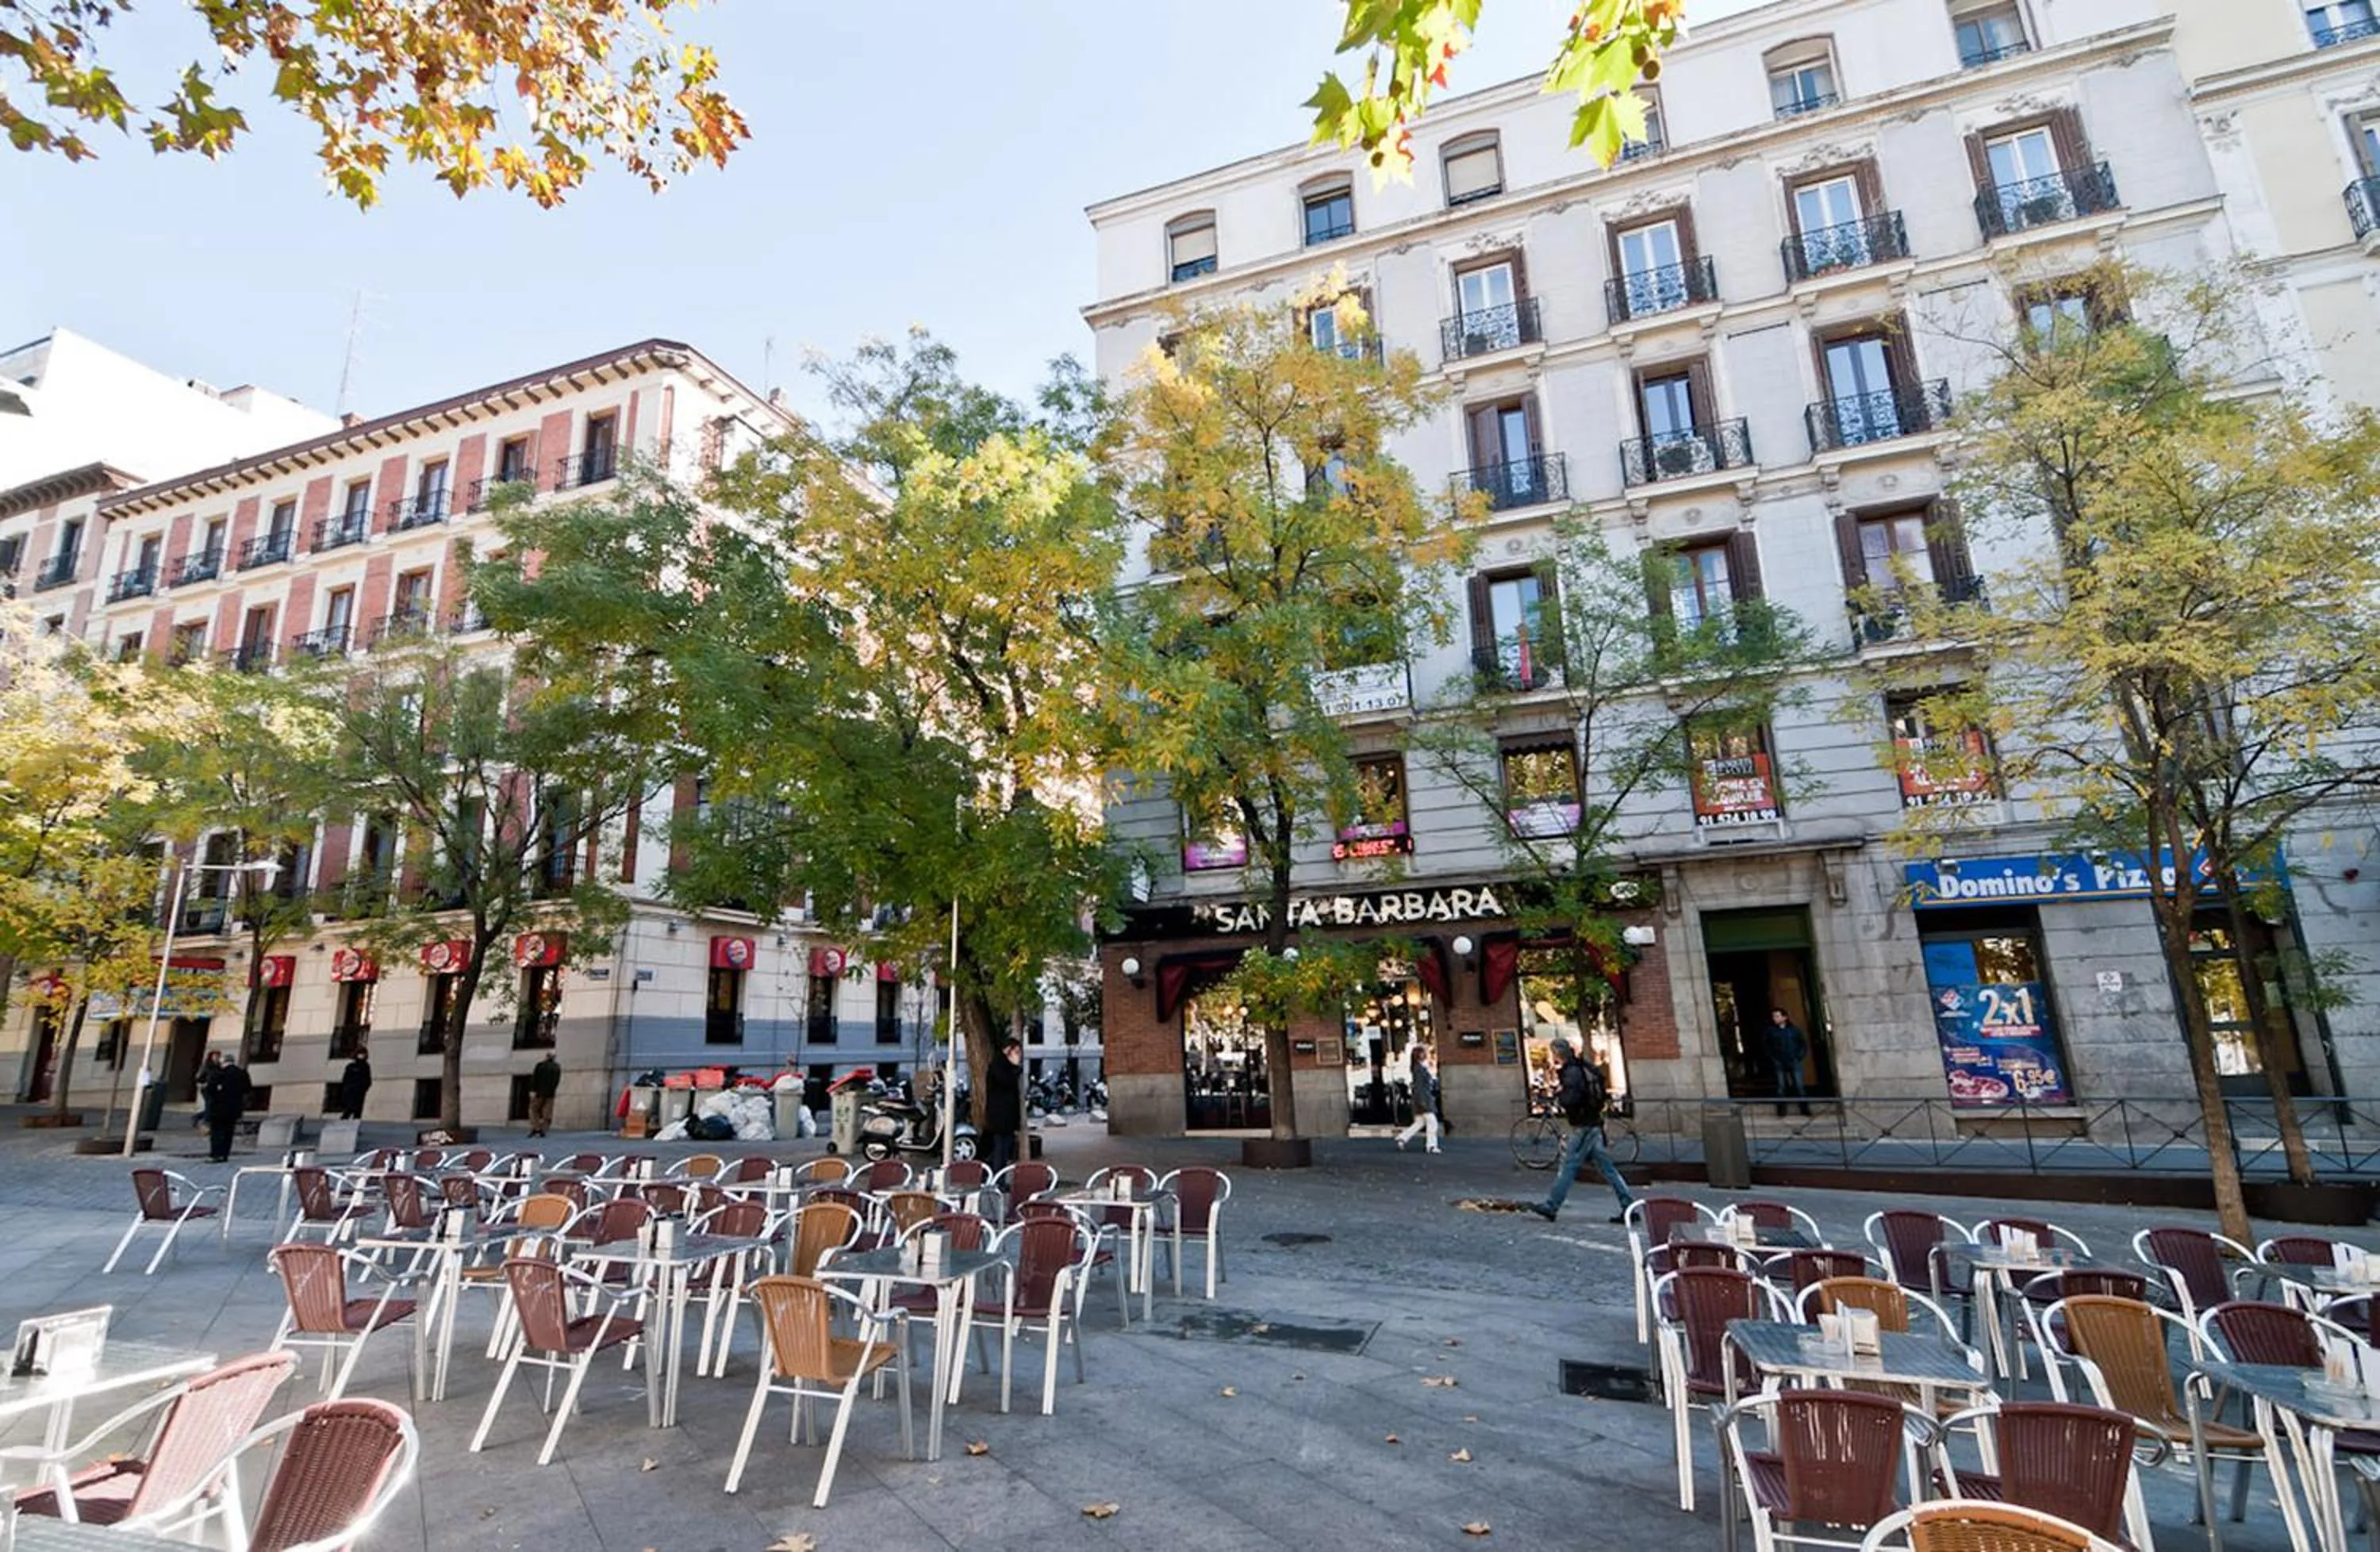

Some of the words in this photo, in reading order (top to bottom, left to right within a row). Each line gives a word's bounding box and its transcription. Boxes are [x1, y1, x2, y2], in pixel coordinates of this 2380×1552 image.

[1938, 868, 2080, 900] Domino's
[2094, 862, 2177, 890] Piza
[1215, 898, 1322, 934] SANTA
[1334, 886, 1506, 925] BARBARA
[1978, 987, 2035, 1025] 2x1
